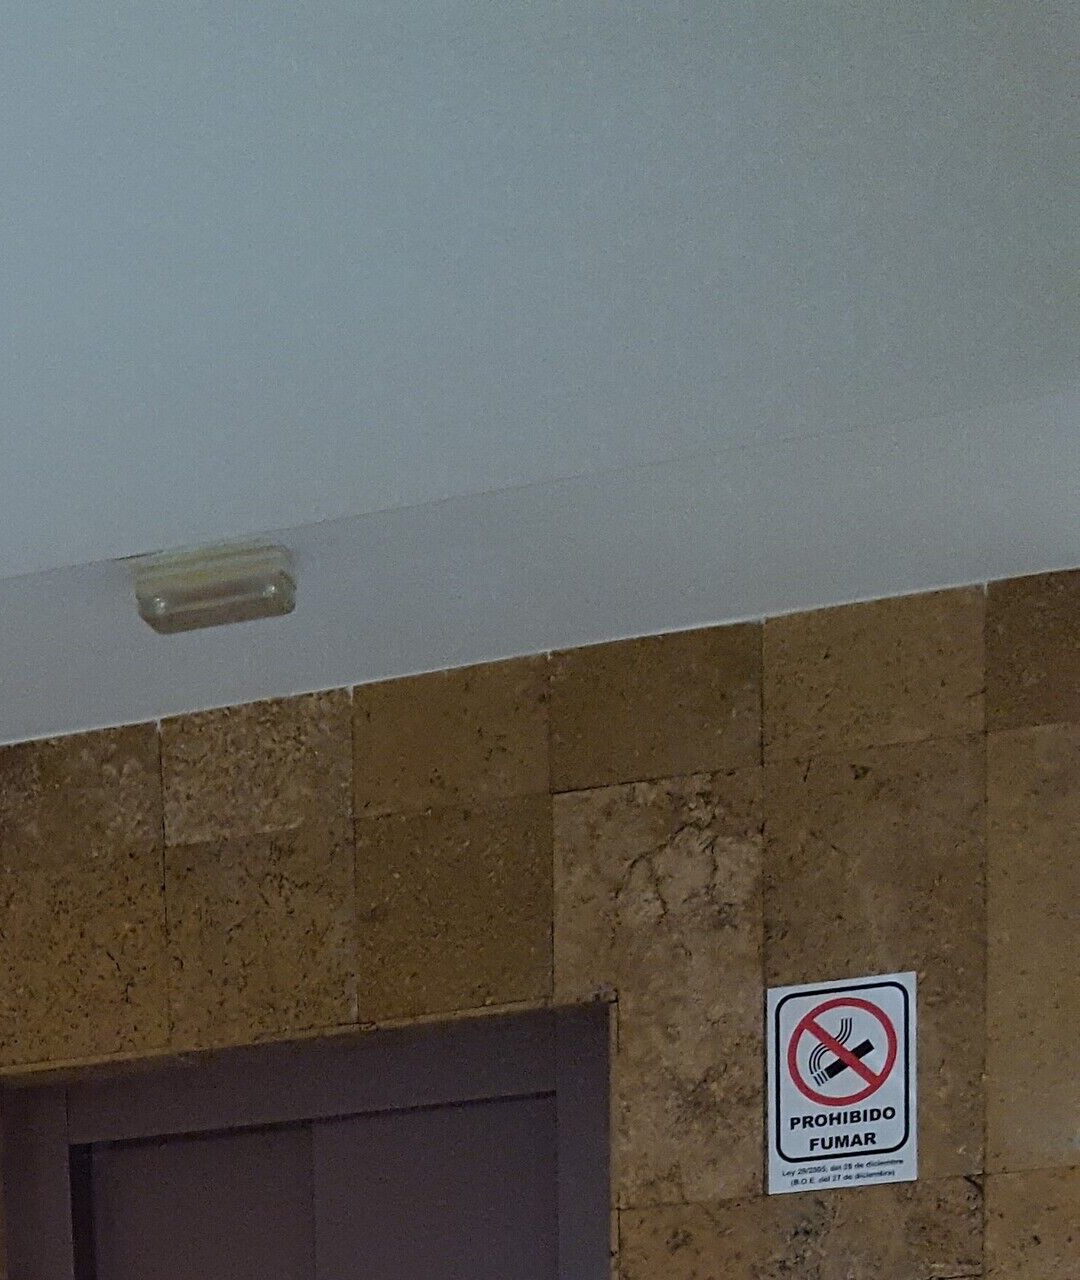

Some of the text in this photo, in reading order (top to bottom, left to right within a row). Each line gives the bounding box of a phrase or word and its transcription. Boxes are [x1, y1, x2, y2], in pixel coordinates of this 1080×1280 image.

[790, 1107, 896, 1130] PROHIBIDO
[810, 1133, 876, 1151] FUMAR
[782, 1167, 796, 1176] Ley
[818, 1175, 830, 1183] del
